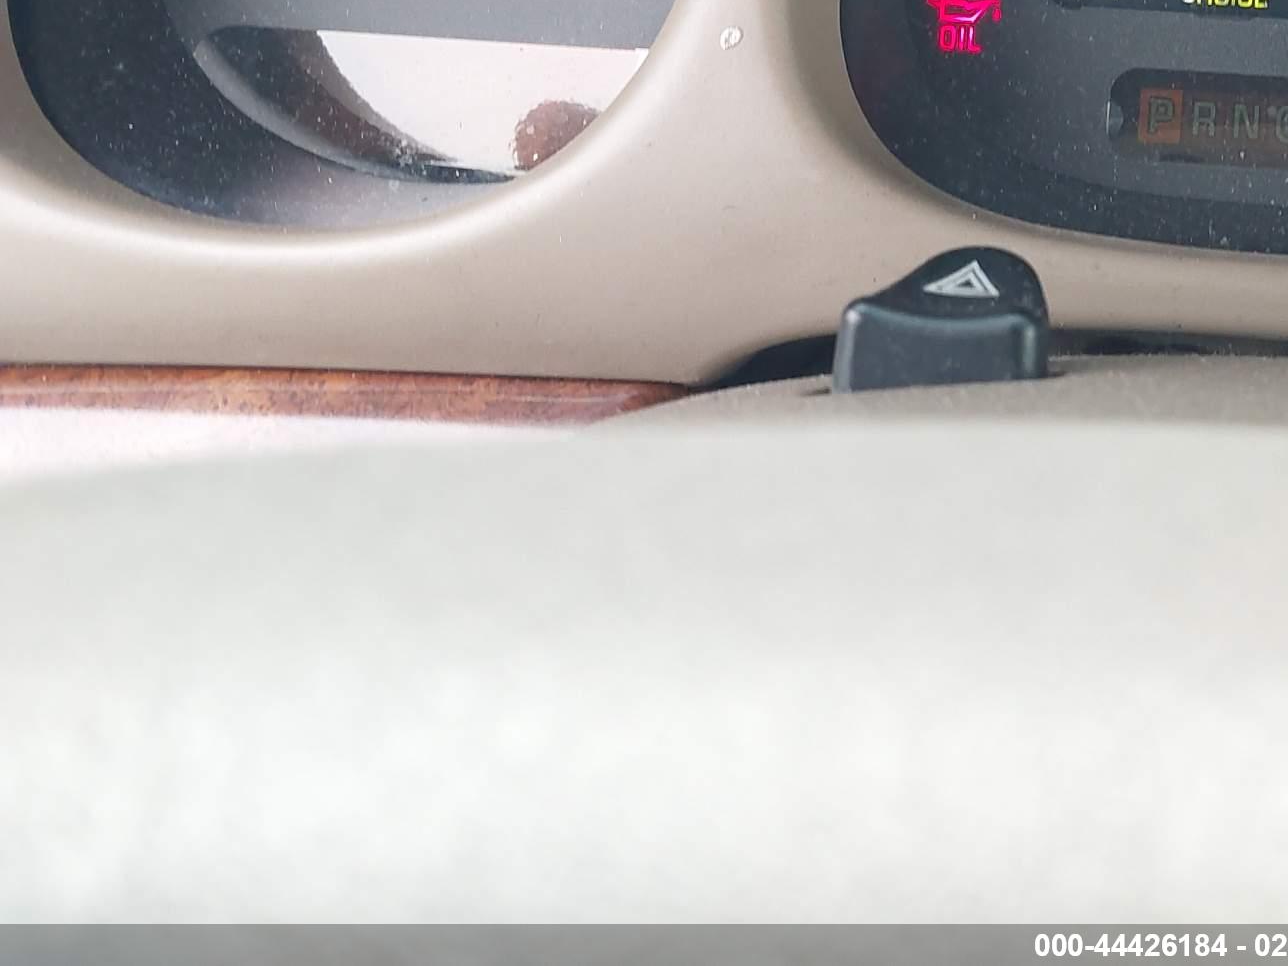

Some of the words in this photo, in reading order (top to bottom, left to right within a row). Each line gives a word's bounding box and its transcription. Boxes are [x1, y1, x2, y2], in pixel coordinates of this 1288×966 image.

[939, 24, 983, 54] OIL
[1148, 97, 1175, 134] P
[1192, 101, 1216, 138] R
[1233, 103, 1261, 140] N
